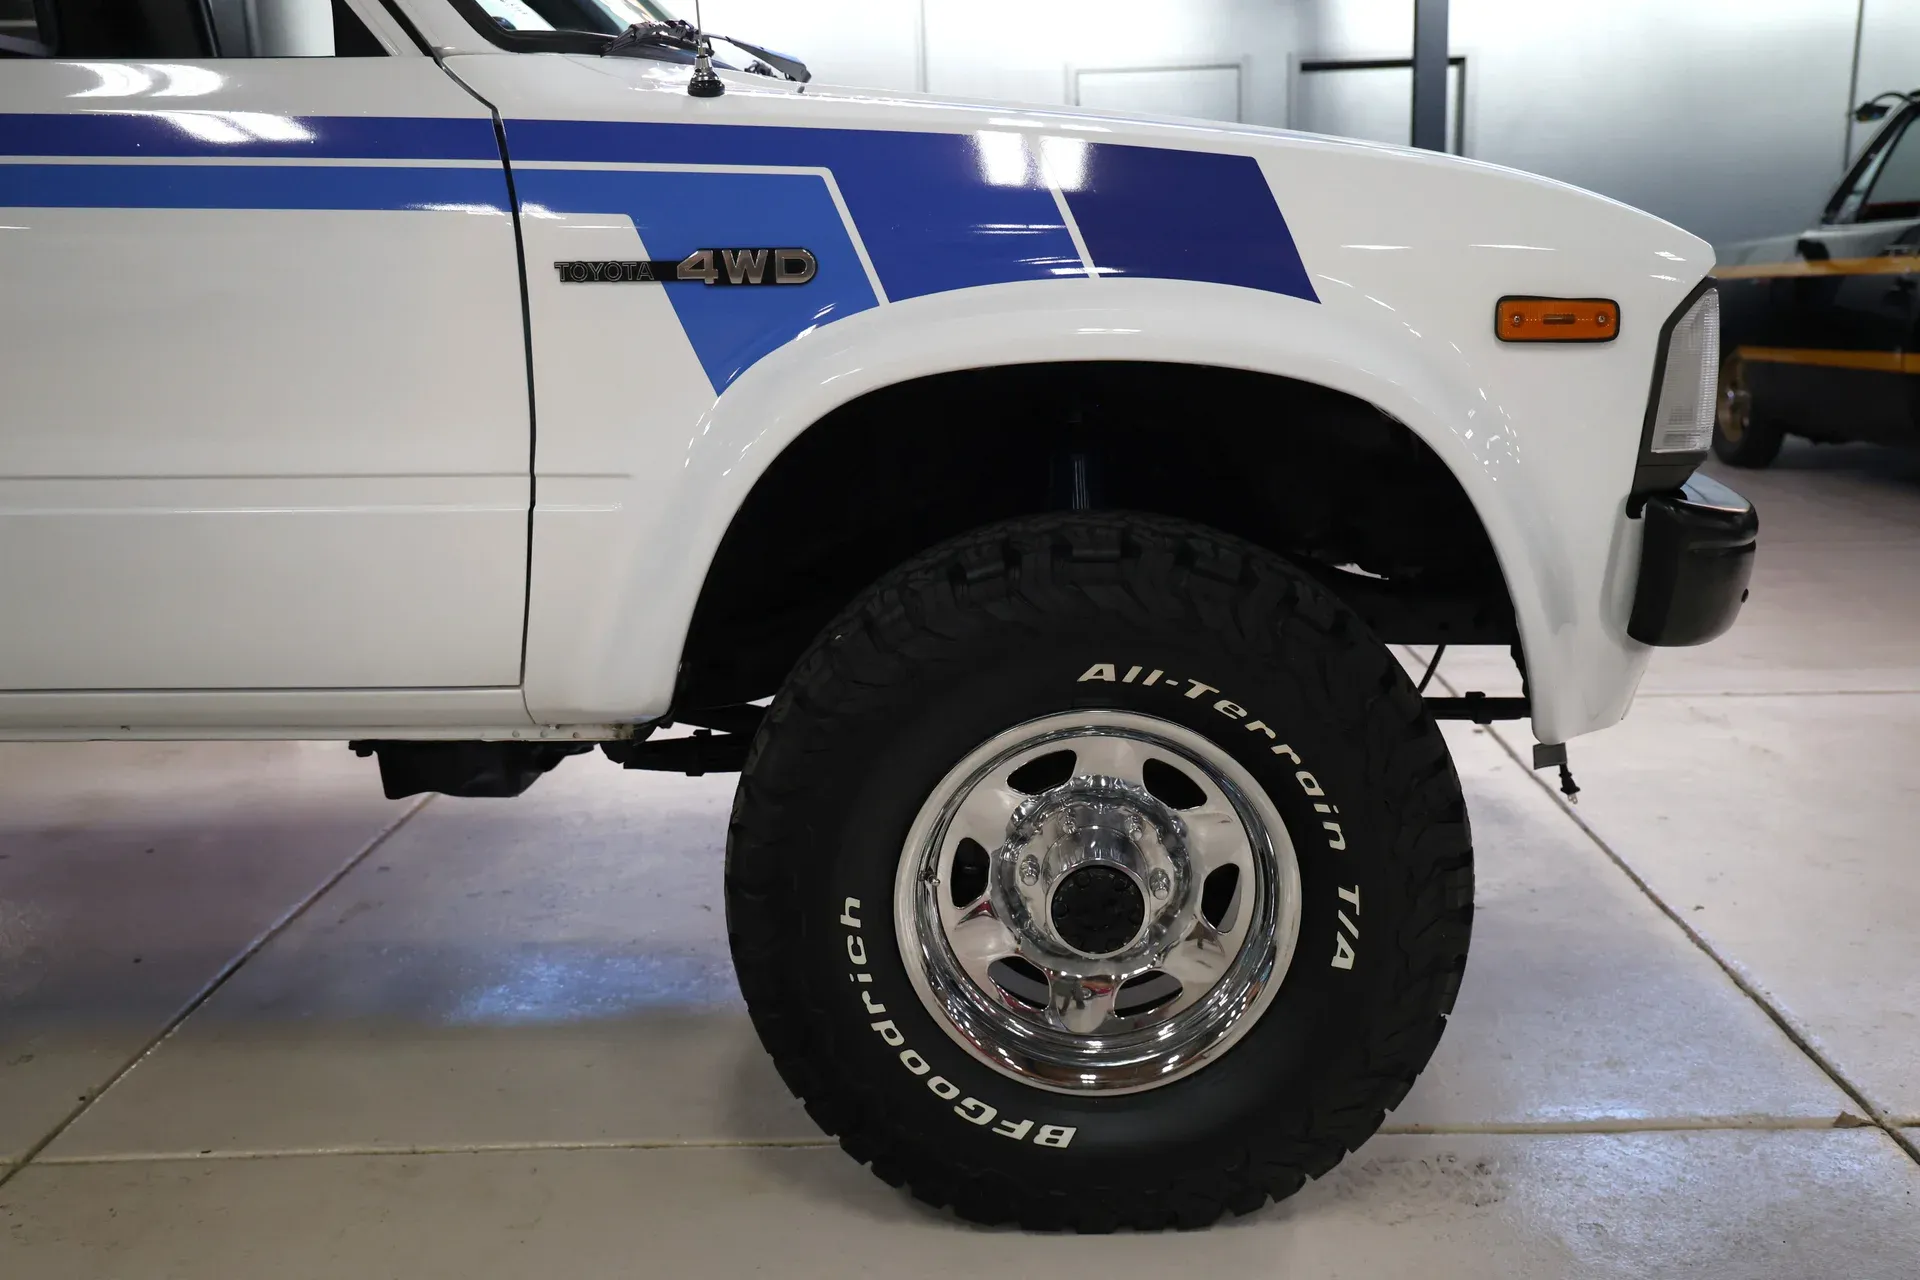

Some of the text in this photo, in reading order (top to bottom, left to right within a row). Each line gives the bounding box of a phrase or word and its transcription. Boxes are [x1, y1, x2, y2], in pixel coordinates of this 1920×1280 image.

[554, 249, 816, 285] TOYOTA 4WD
[1077, 663, 1360, 970] All-Terrain T/A
[840, 896, 1077, 1148] BFGoodrich
